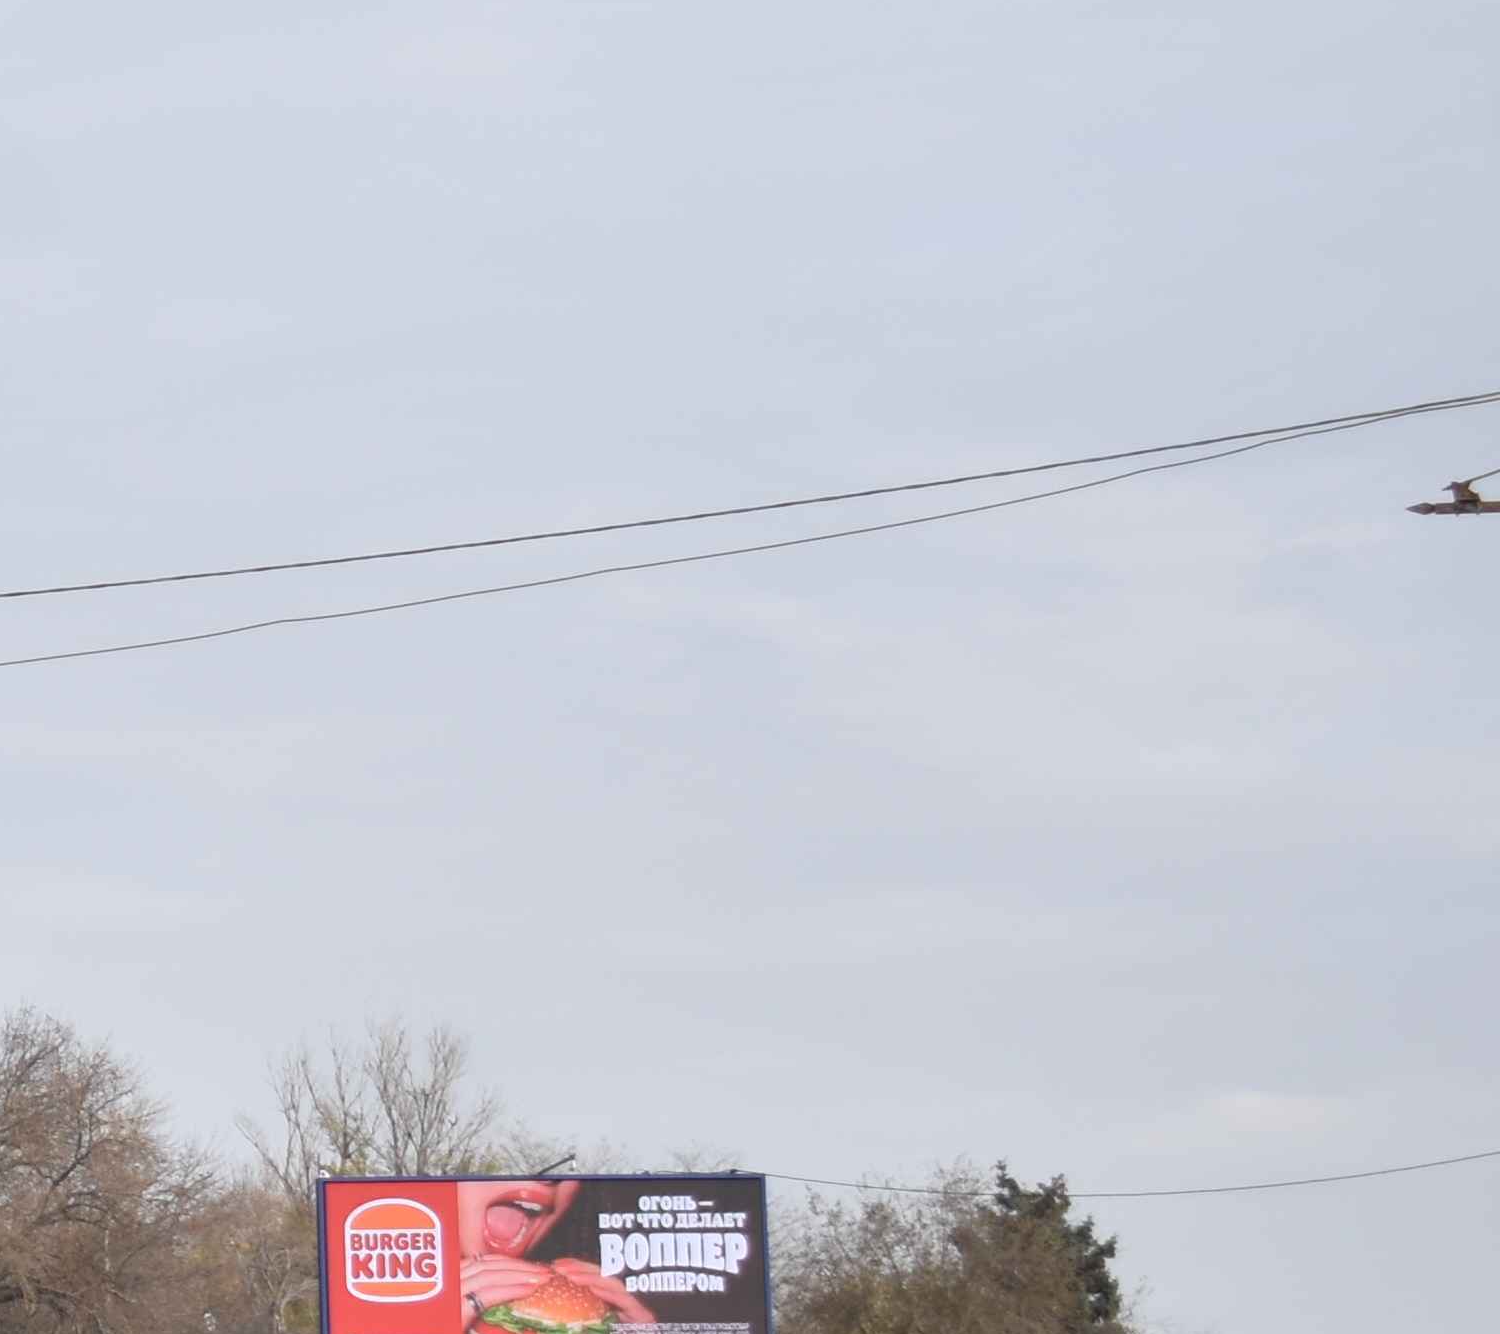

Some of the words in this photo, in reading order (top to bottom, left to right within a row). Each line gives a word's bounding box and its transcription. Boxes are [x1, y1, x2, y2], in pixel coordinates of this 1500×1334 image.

[638, 1196, 697, 1211] ОГОНЬ
[598, 1213, 635, 1229] ВОТ
[636, 1212, 674, 1229] ЧТО
[675, 1212, 747, 1229] ДЕЛАЕТ
[349, 1232, 437, 1252] BURGER
[350, 1251, 438, 1280] KING
[599, 1232, 749, 1278] ВОППЕР
[625, 1271, 725, 1293] ВОППЕРОМ
